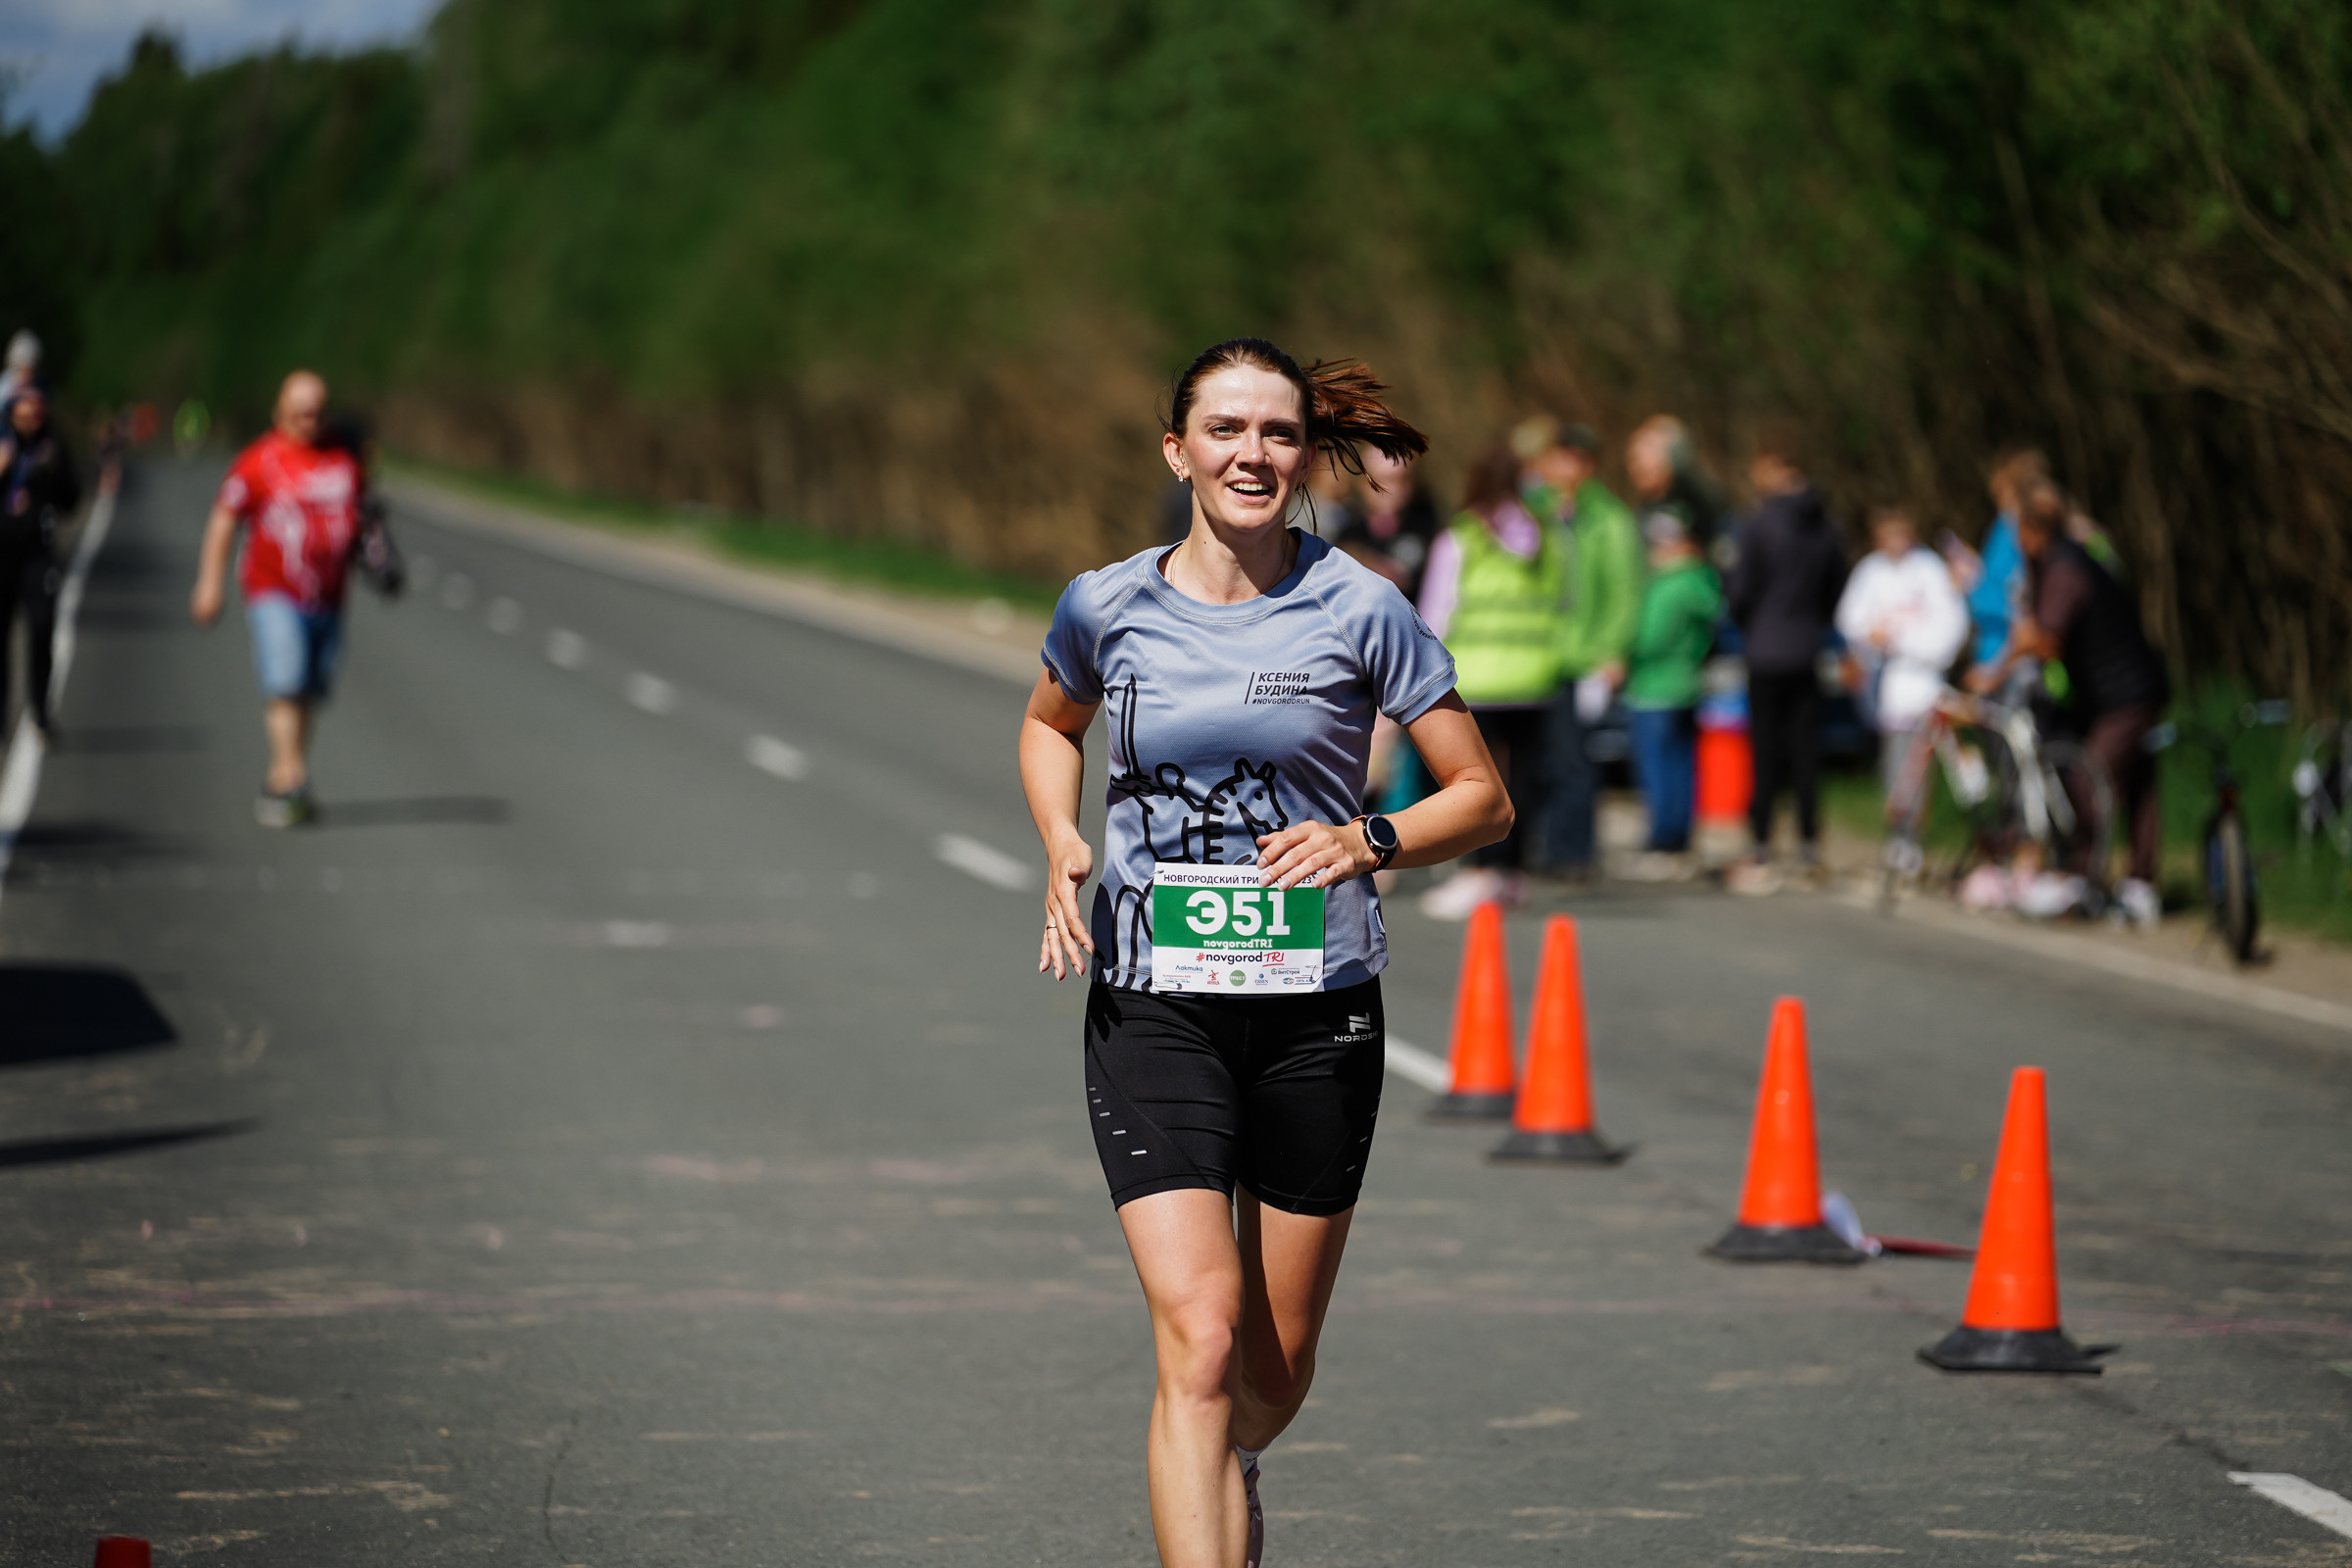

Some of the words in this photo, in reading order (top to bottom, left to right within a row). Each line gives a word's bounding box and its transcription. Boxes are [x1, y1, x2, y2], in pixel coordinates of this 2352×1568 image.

[1258, 672, 1310, 683] КСЕНИЯ
[1254, 685, 1307, 697] БУДИНА
[1163, 874, 1240, 885] НОВГОРОДСКИЙ
[1185, 890, 1291, 937] Э51
[1202, 938, 1273, 950] novgorodTRI
